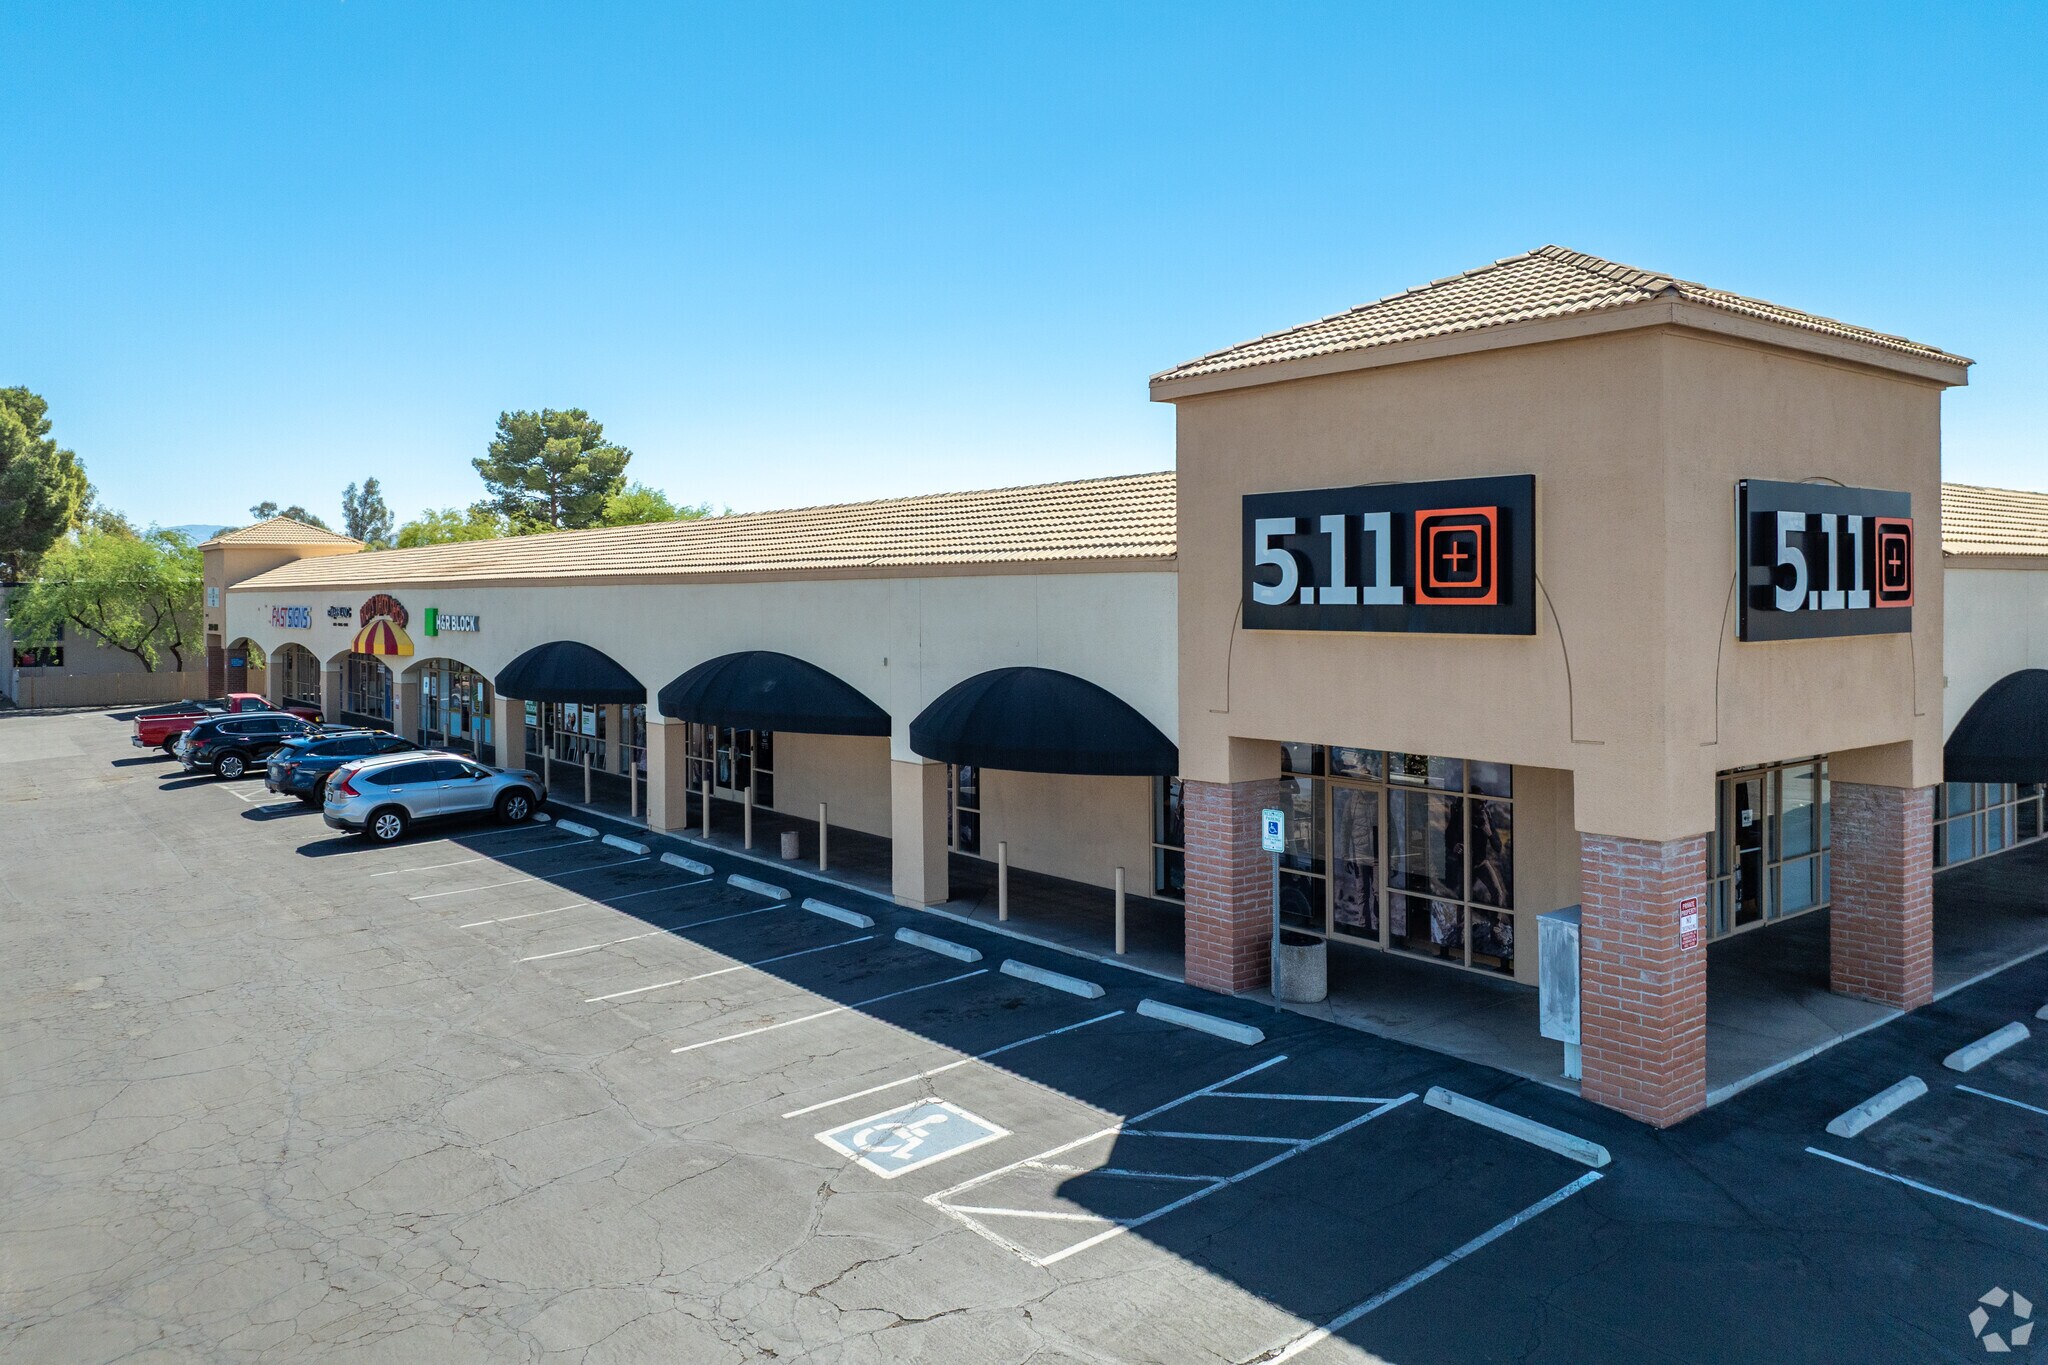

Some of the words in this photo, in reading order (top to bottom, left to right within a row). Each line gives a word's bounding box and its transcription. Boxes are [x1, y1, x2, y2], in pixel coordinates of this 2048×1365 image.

[1253, 511, 1404, 606] 5.11
[1775, 510, 1871, 613] 5.11
[271, 607, 311, 629] FASTSIGNS
[436, 615, 451, 631] H&R
[451, 615, 476, 632] BLOCK
